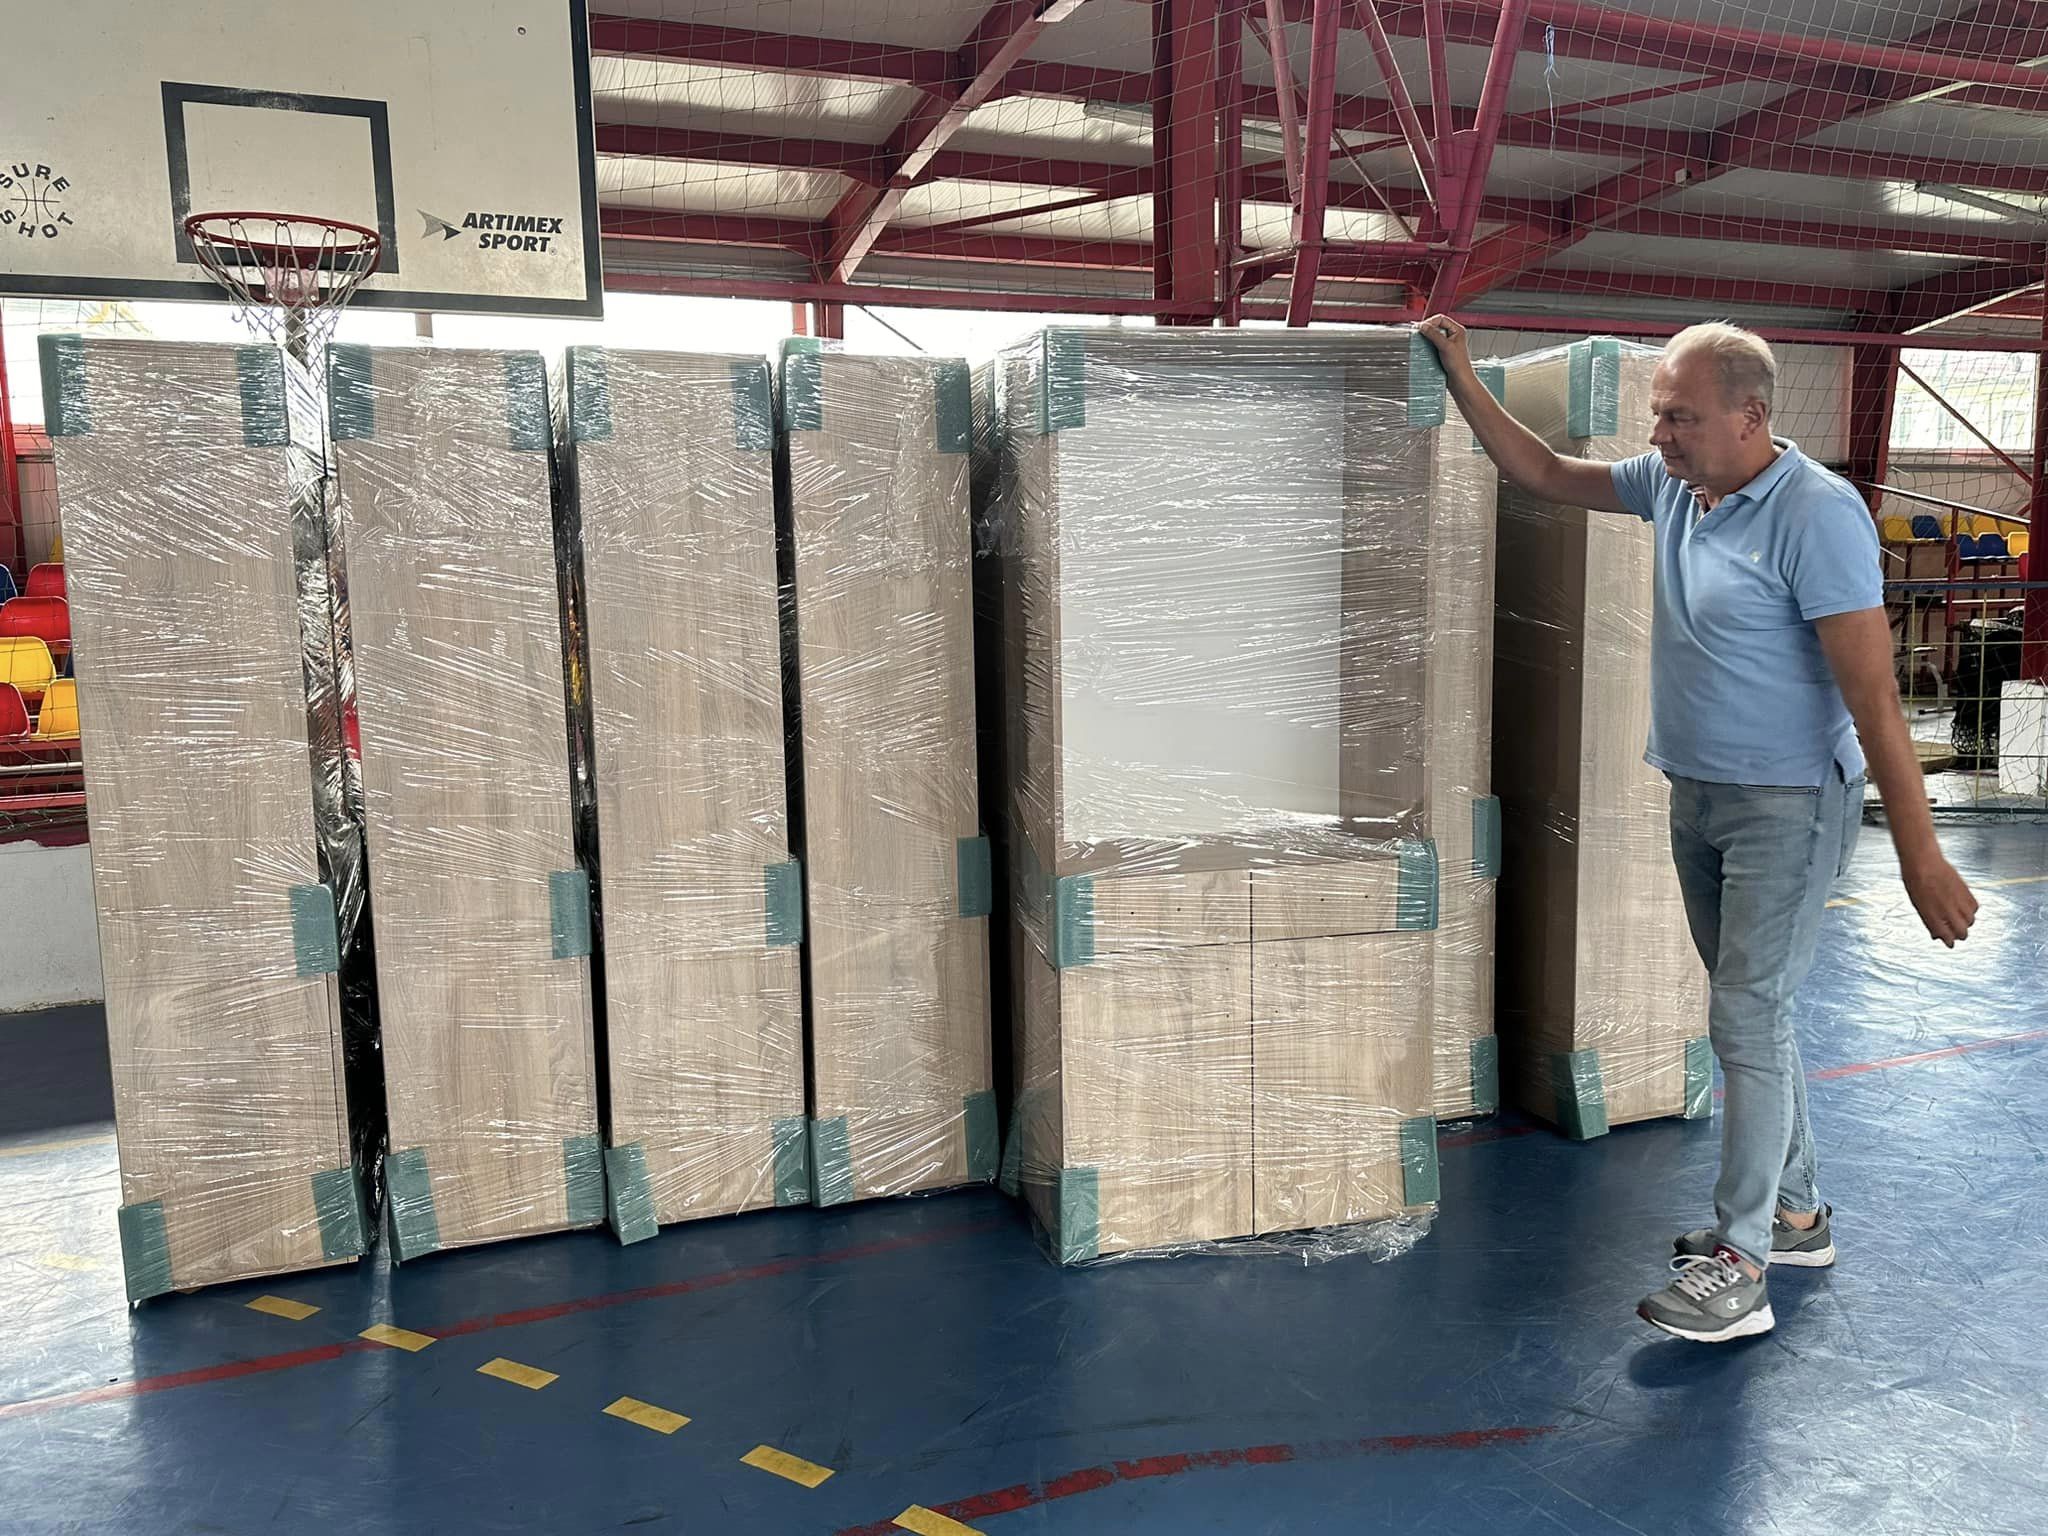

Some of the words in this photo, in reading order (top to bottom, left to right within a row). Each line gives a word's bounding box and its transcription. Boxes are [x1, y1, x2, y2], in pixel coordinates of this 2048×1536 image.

[0, 162, 71, 192] SURE
[0, 209, 74, 239] SHOT
[461, 212, 564, 234] ARTIMEX
[478, 232, 551, 253] SPORT
